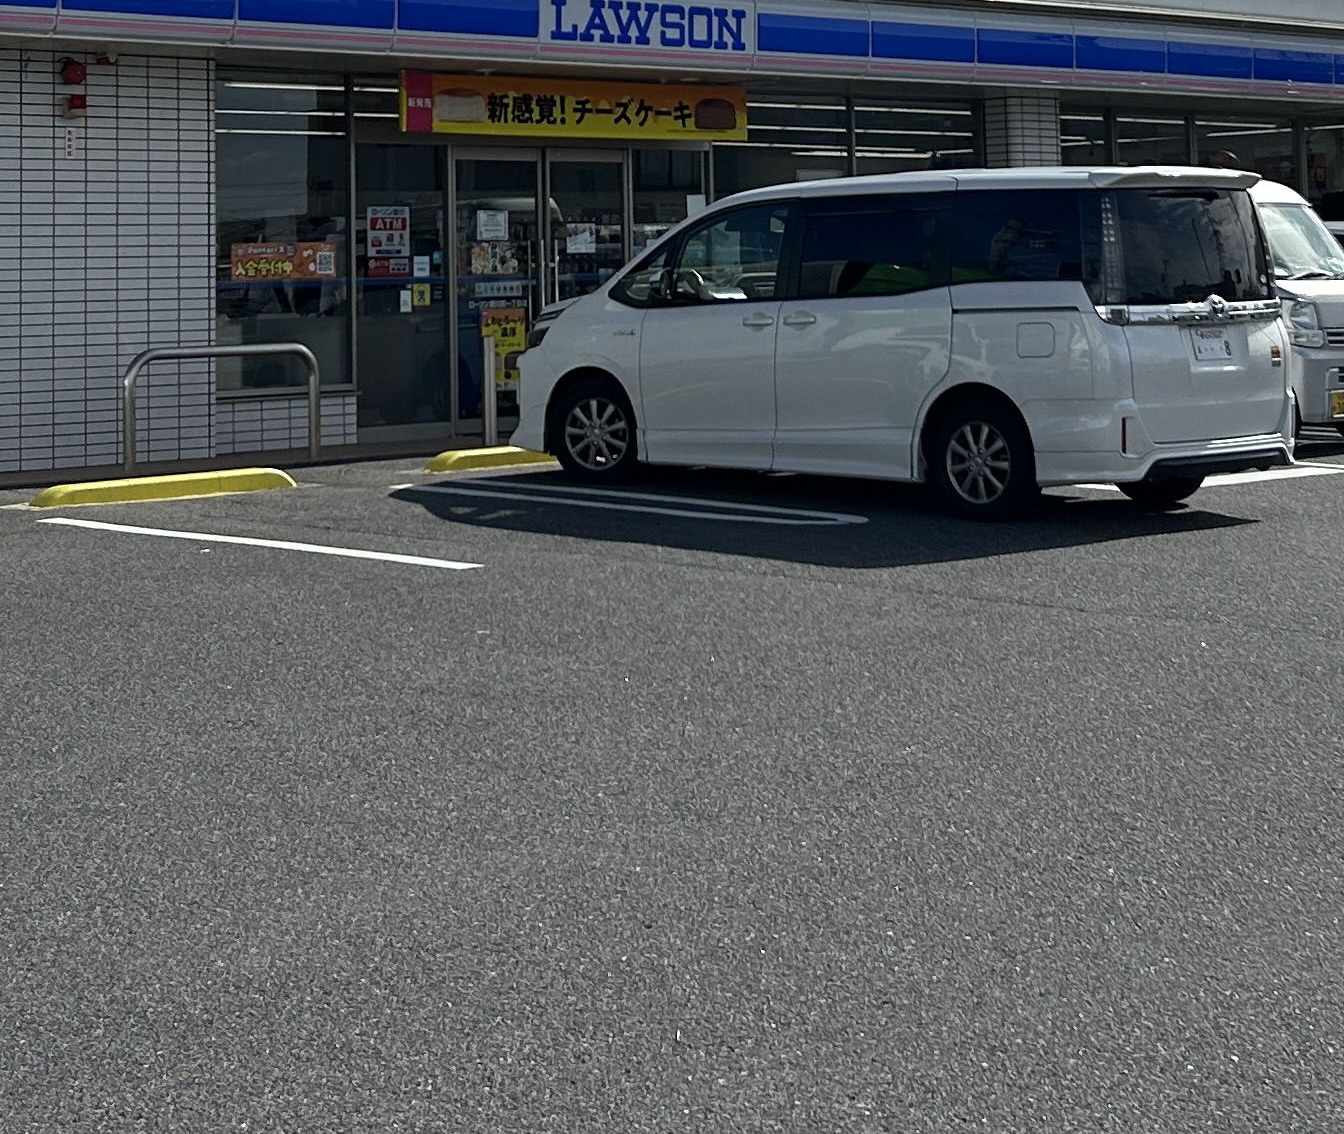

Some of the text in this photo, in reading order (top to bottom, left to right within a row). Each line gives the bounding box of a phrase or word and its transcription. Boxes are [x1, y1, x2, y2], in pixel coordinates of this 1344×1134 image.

[407, 96, 432, 109] 新発売
[375, 218, 403, 230] ATM
